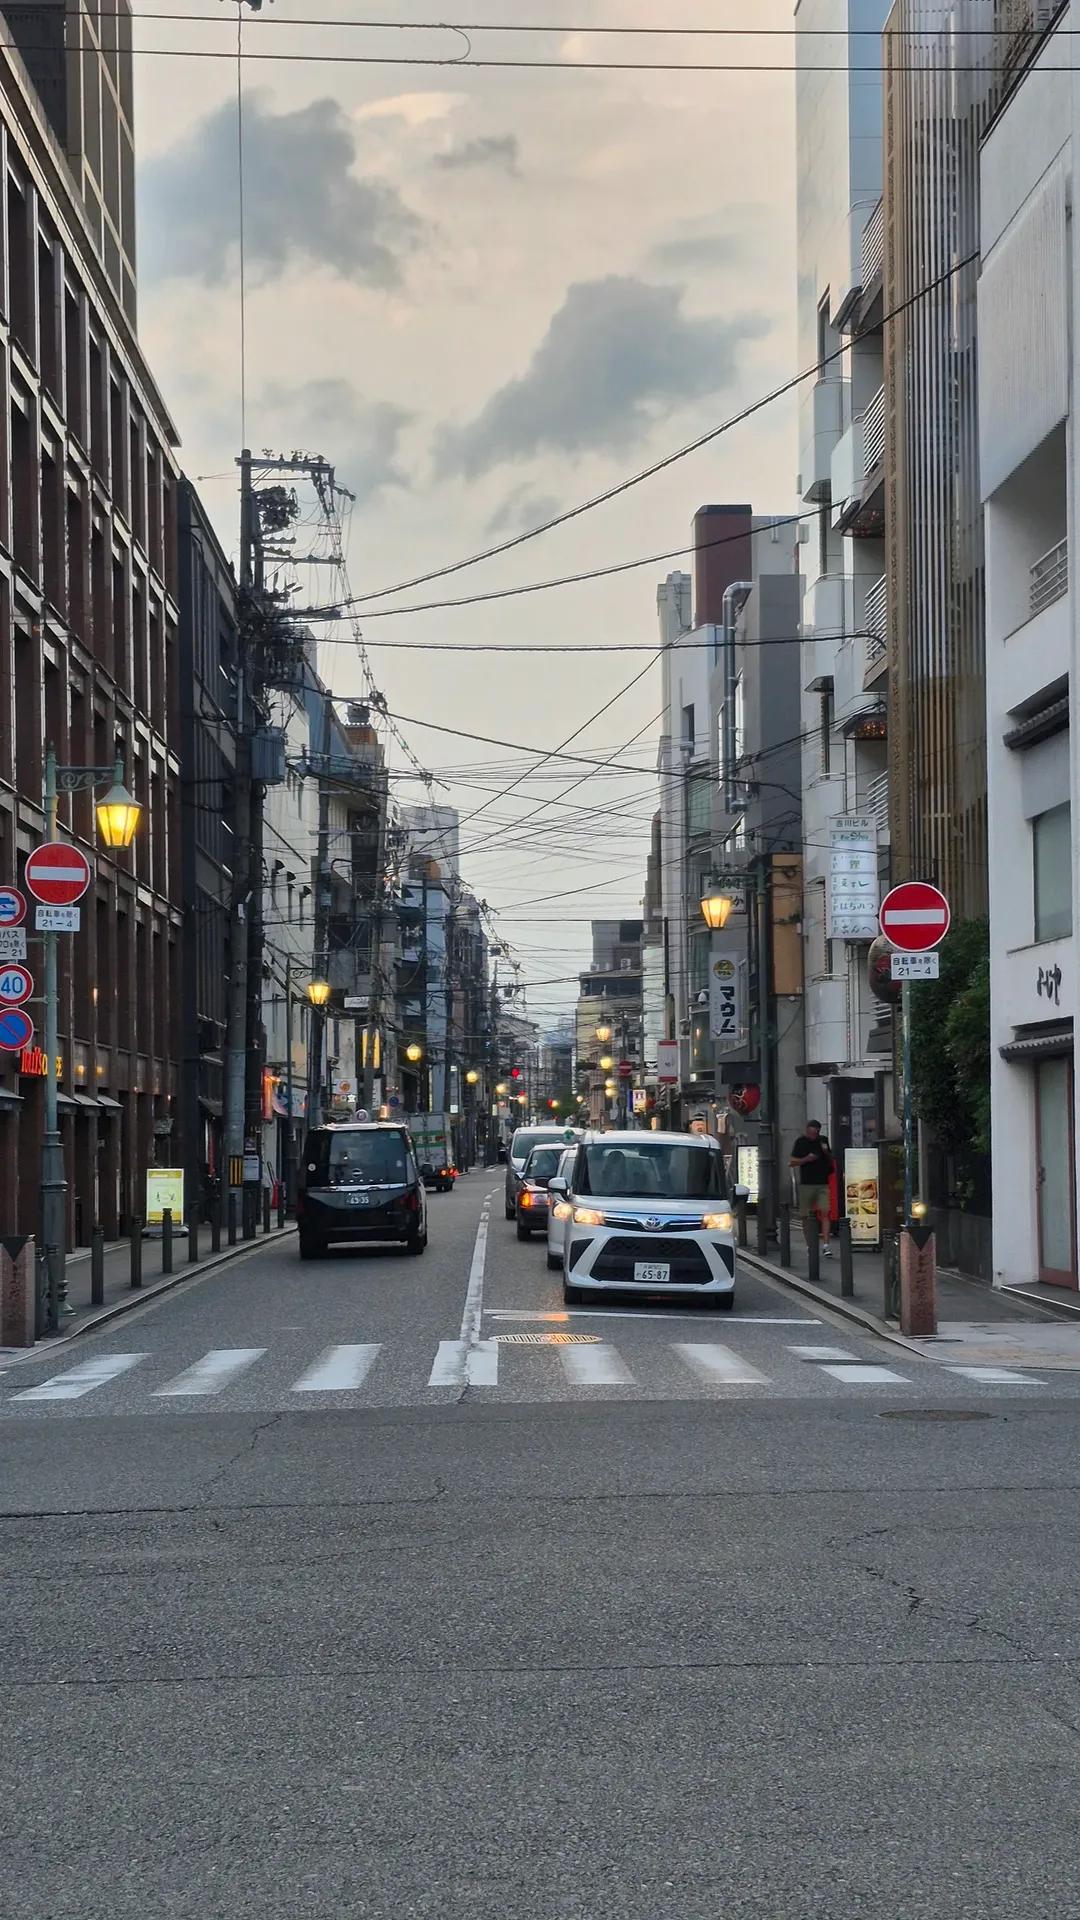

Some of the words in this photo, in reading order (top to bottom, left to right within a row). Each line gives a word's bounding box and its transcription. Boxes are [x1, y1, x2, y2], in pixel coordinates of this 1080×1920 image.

[893, 956, 937, 966] 自転車を除く
[0, 977, 24, 994] 40
[720, 985, 736, 1034] マウム
[642, 1269, 668, 1280] 65-87
